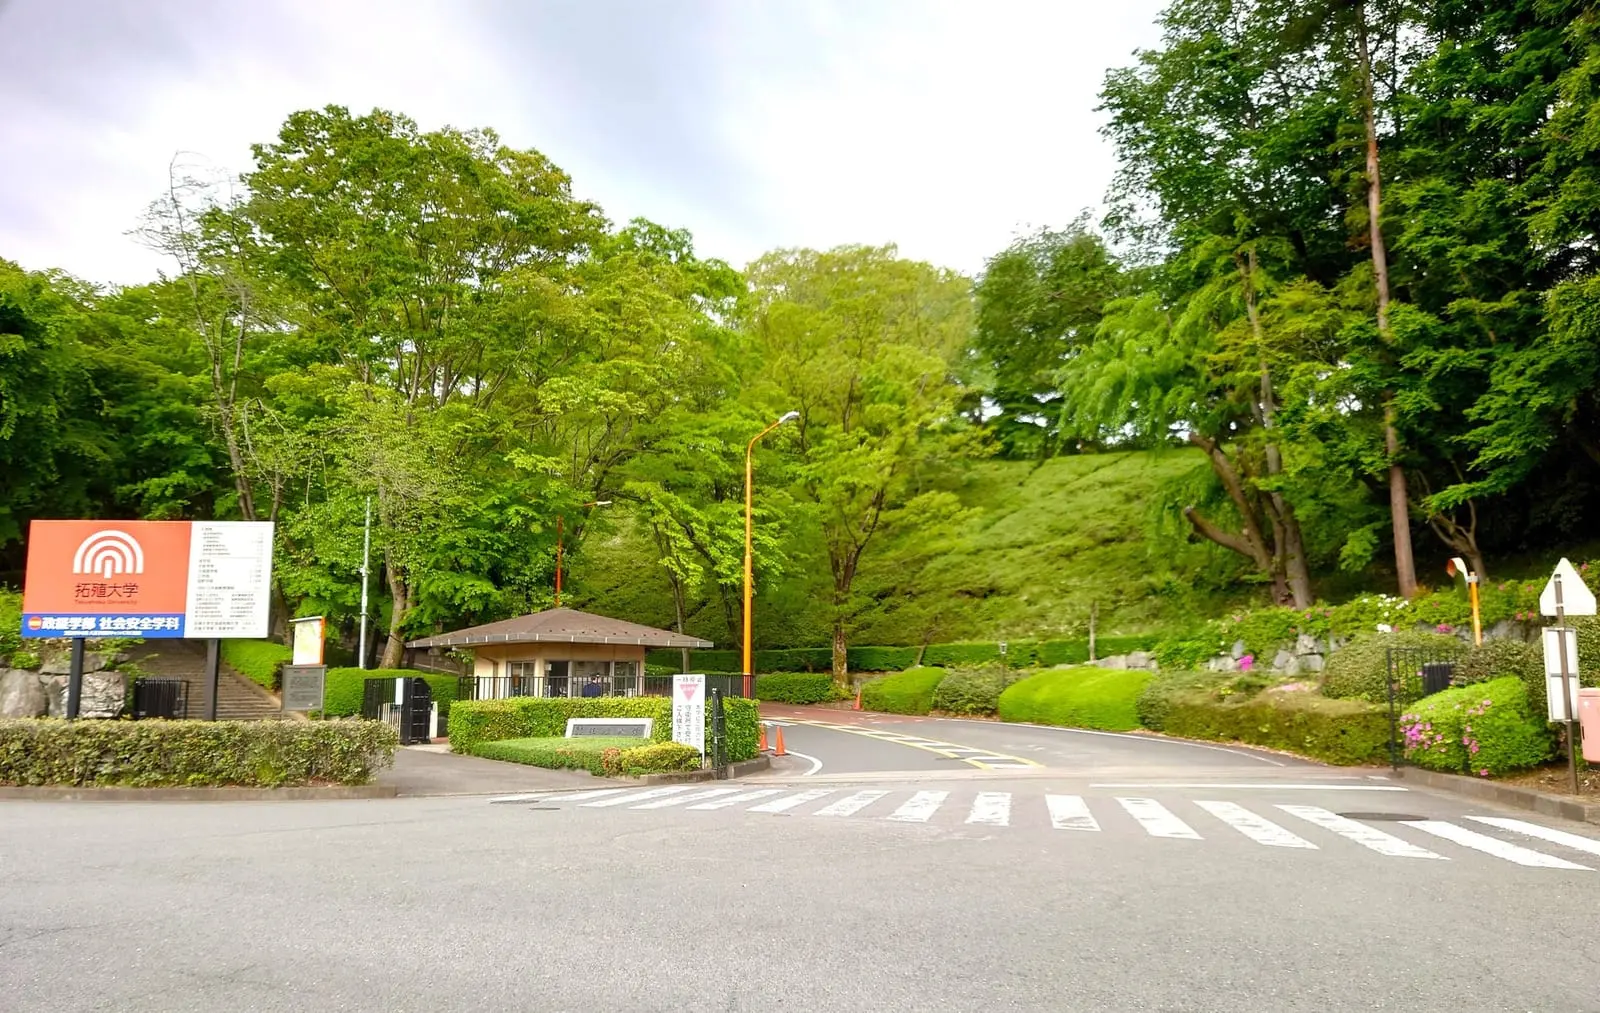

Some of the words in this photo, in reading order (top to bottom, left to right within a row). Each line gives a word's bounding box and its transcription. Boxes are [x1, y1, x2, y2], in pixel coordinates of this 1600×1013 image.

[75, 582, 139, 598] 拓殖大学
[99, 616, 180, 630] 社会安全学科
